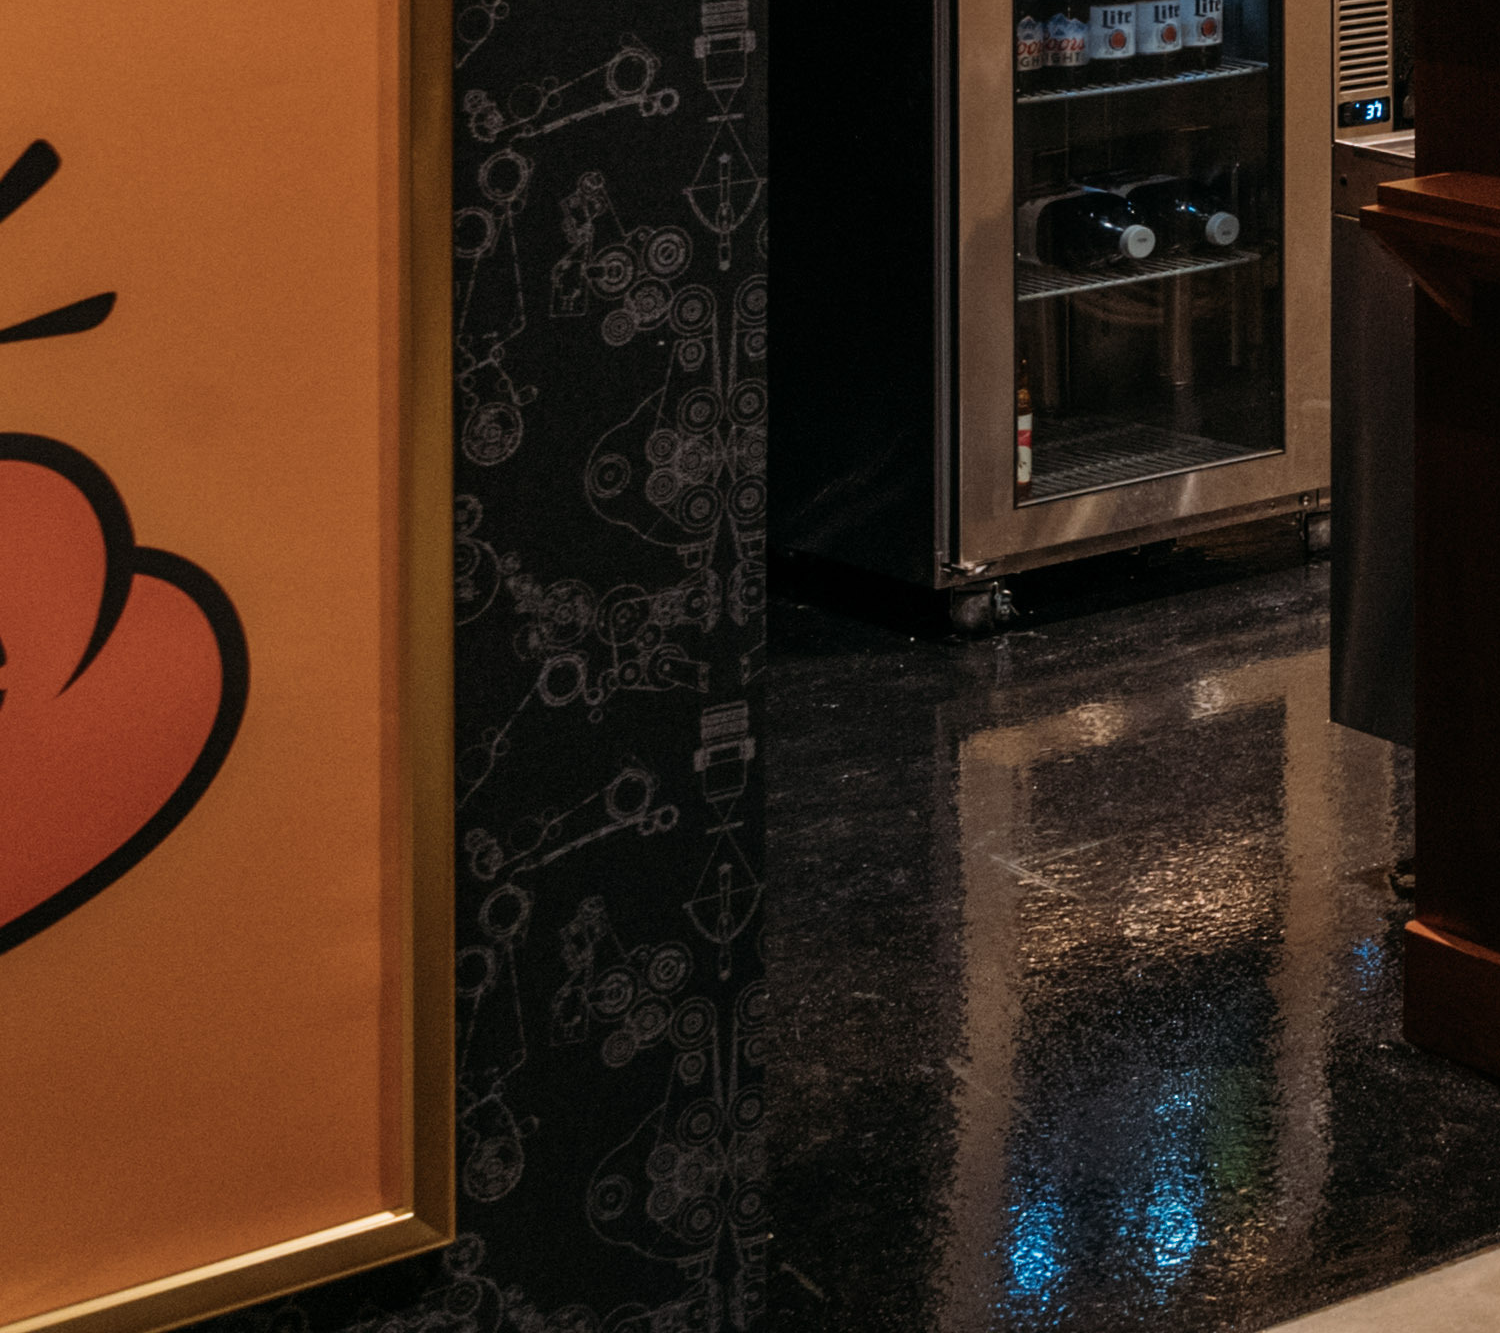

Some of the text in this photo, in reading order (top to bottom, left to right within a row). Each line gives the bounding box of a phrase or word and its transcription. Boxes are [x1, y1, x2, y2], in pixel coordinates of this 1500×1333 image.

[1102, 8, 1133, 30] Lite
[1153, 2, 1181, 25] Lite
[1364, 99, 1384, 122] 37
